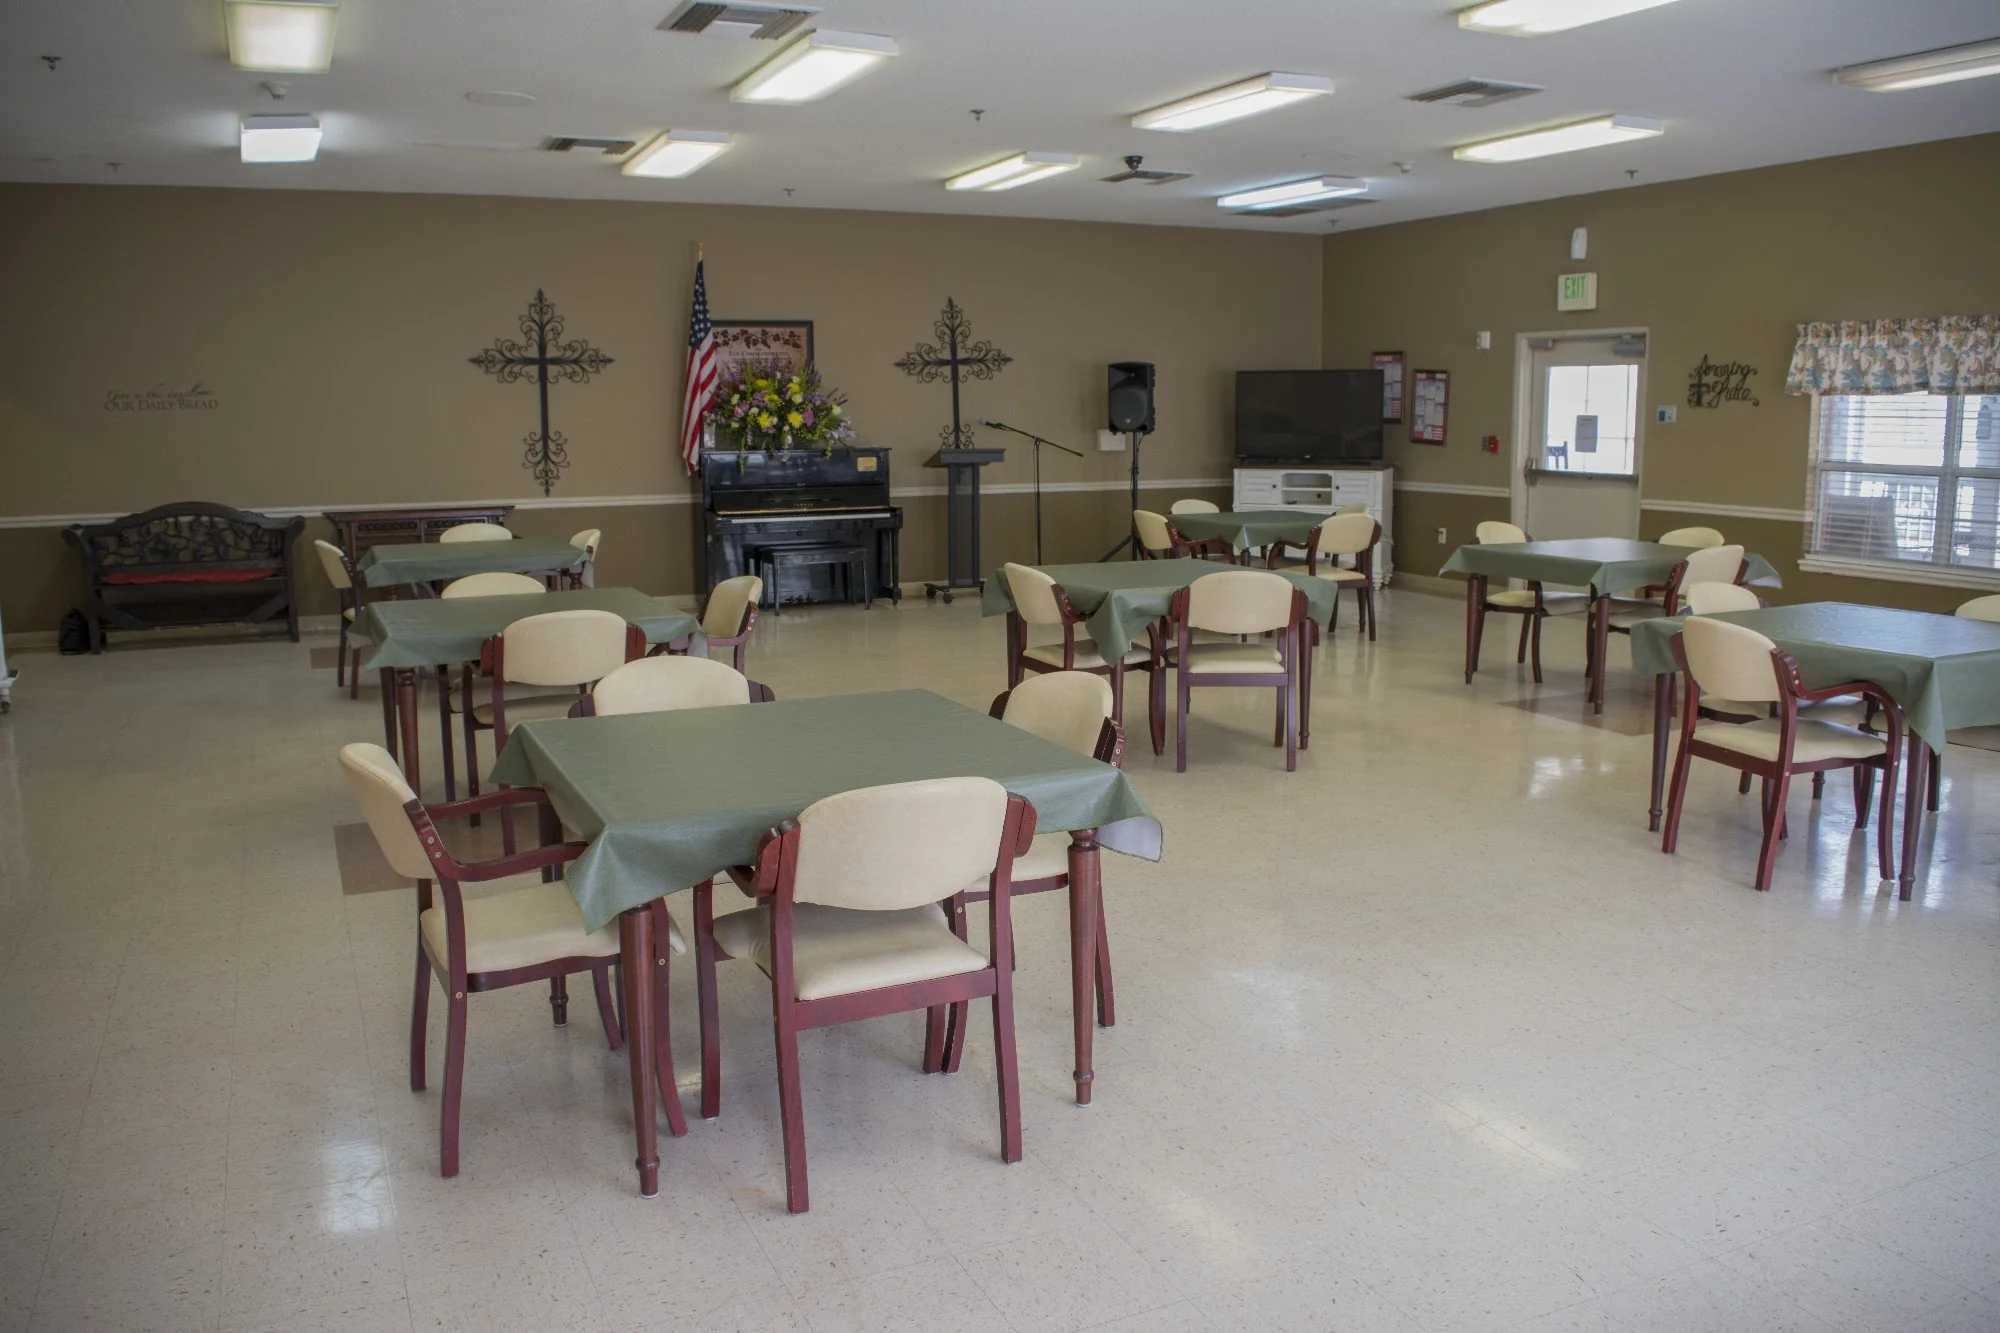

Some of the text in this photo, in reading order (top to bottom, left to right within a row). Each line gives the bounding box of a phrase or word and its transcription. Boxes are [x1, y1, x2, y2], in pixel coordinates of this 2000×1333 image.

[1564, 276, 1585, 299] EXIT
[104, 399, 218, 412] OUR DAILY BREAD
